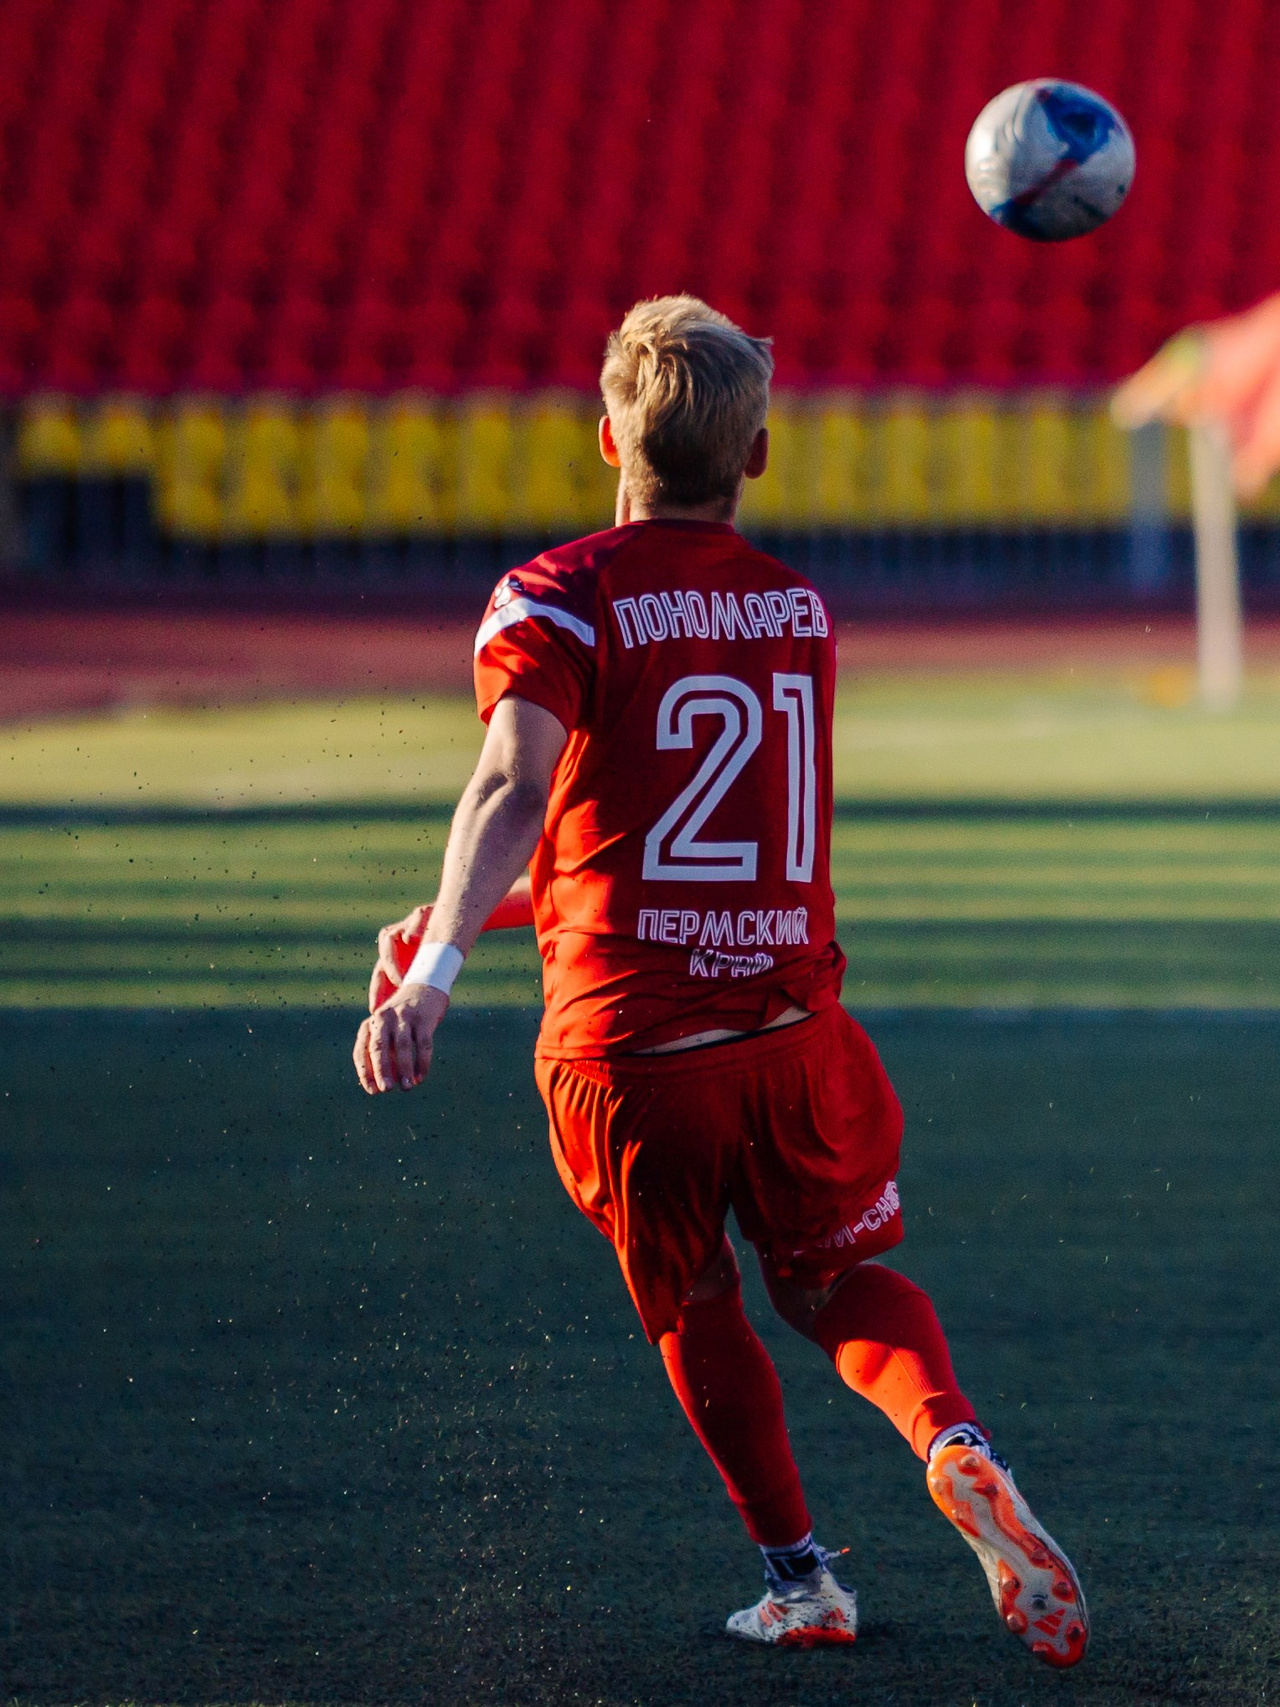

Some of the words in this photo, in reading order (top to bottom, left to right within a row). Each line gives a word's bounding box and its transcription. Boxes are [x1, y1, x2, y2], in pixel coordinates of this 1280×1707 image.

[612, 587, 829, 649] ПОНОМАРЕВ
[642, 672, 817, 883] 21
[637, 906, 809, 946] ПЕРМСКИЙ
